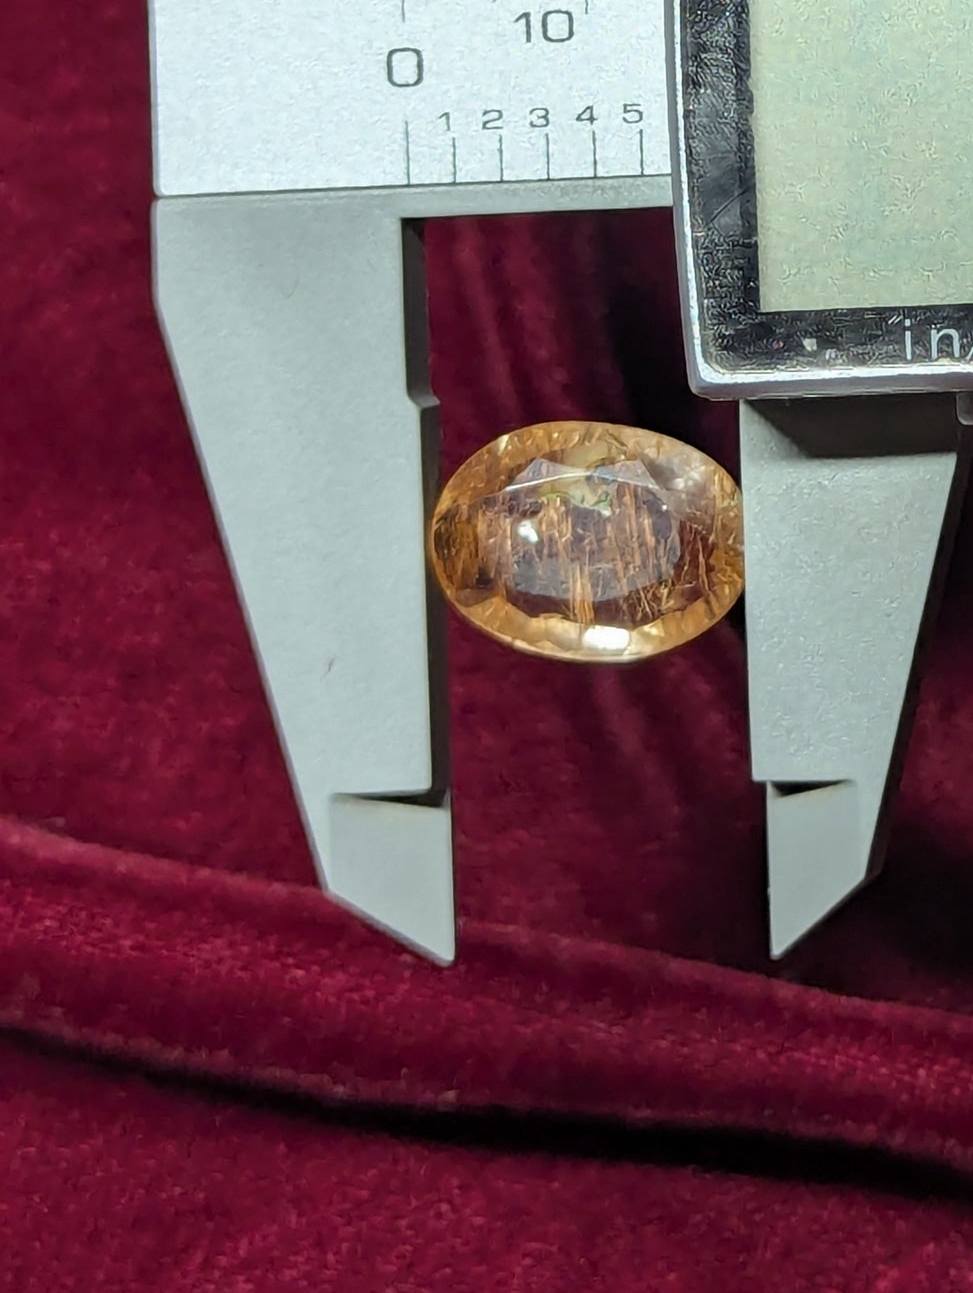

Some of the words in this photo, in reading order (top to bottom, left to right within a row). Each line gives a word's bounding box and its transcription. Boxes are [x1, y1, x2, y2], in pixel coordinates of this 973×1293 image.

[513, 10, 575, 44] 10
[386, 47, 424, 88] 0
[437, 111, 452, 132] 1
[482, 109, 504, 131] 2
[529, 108, 551, 129] 3
[576, 105, 598, 126] 4
[622, 103, 644, 124] 5
